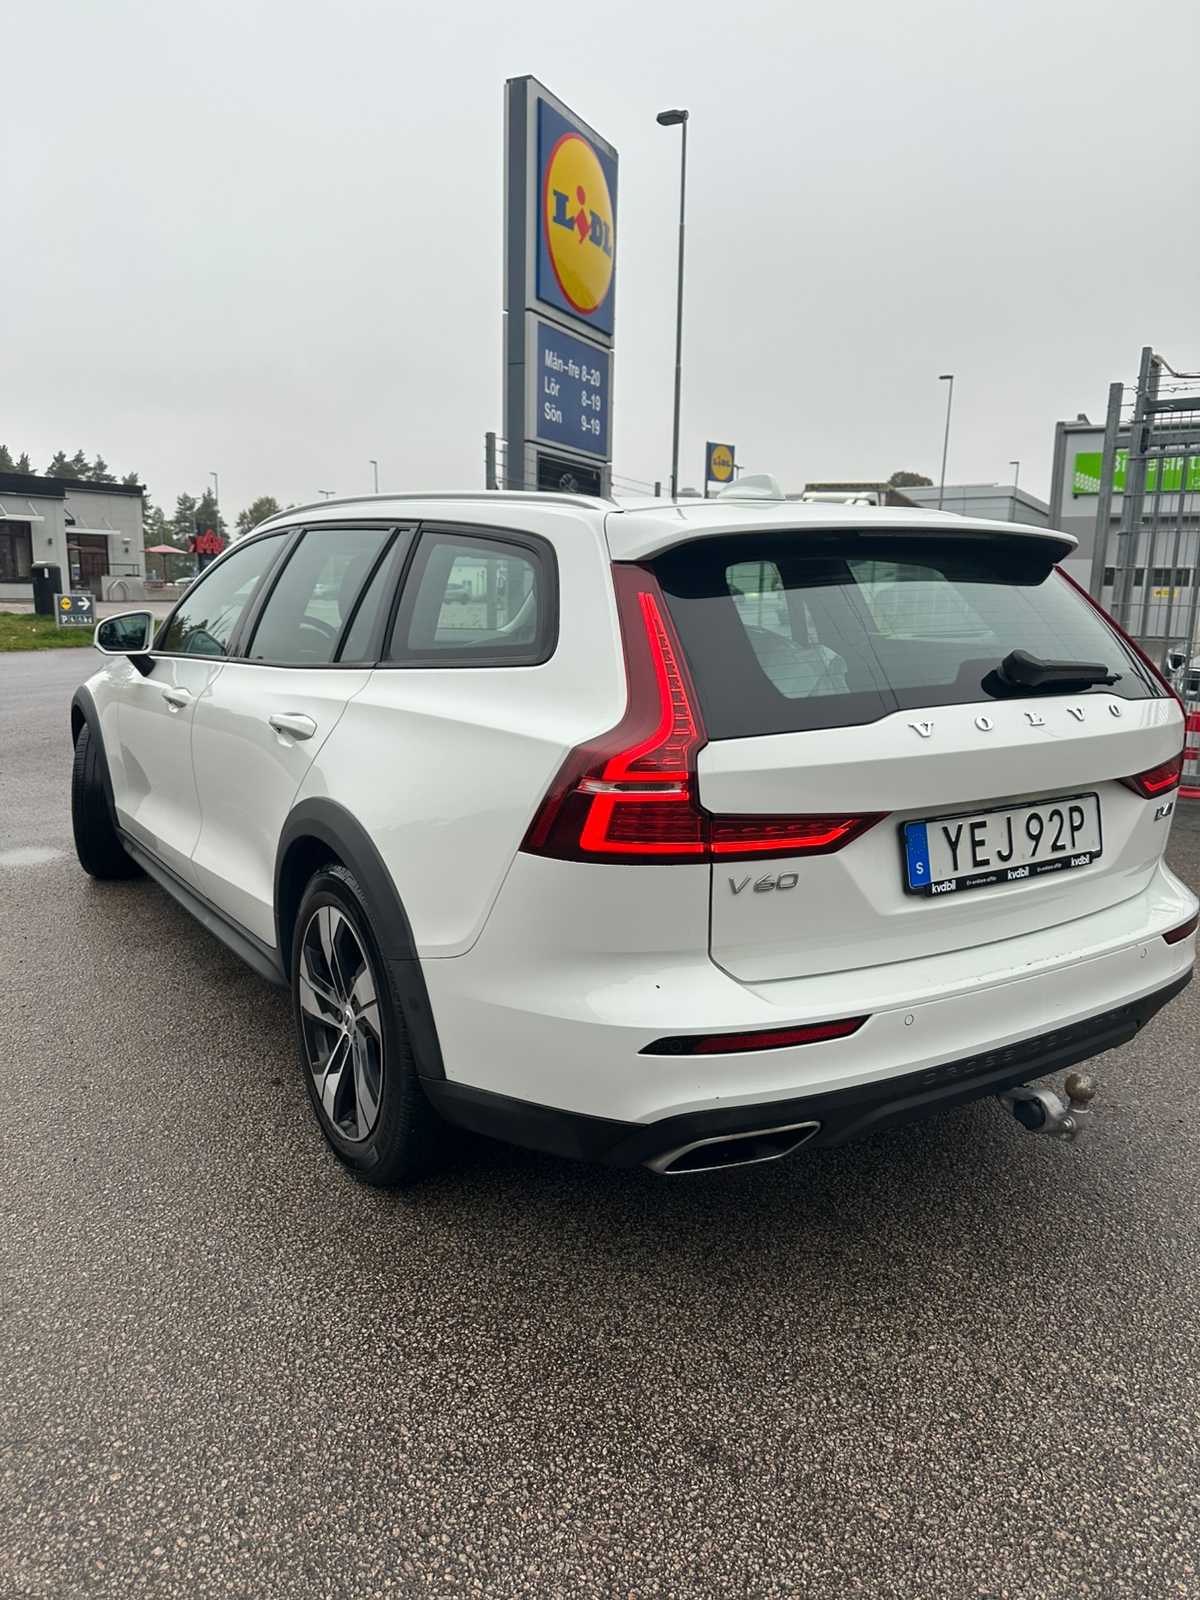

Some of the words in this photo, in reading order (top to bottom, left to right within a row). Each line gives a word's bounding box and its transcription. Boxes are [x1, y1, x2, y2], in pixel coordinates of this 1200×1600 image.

[544, 375, 561, 398] Lör
[581, 390, 601, 412] 8-19
[581, 365, 601, 388] 8-20
[544, 402, 563, 424] Sön
[580, 415, 601, 436] 9-19
[908, 704, 1123, 738] VOLVO
[942, 815, 1014, 872] YEJ
[1025, 804, 1085, 858] 92P
[916, 861, 924, 875] S
[931, 880, 957, 894] kvdbil
[1007, 866, 1030, 880] kvdbil
[1071, 854, 1090, 867] kvdbil
